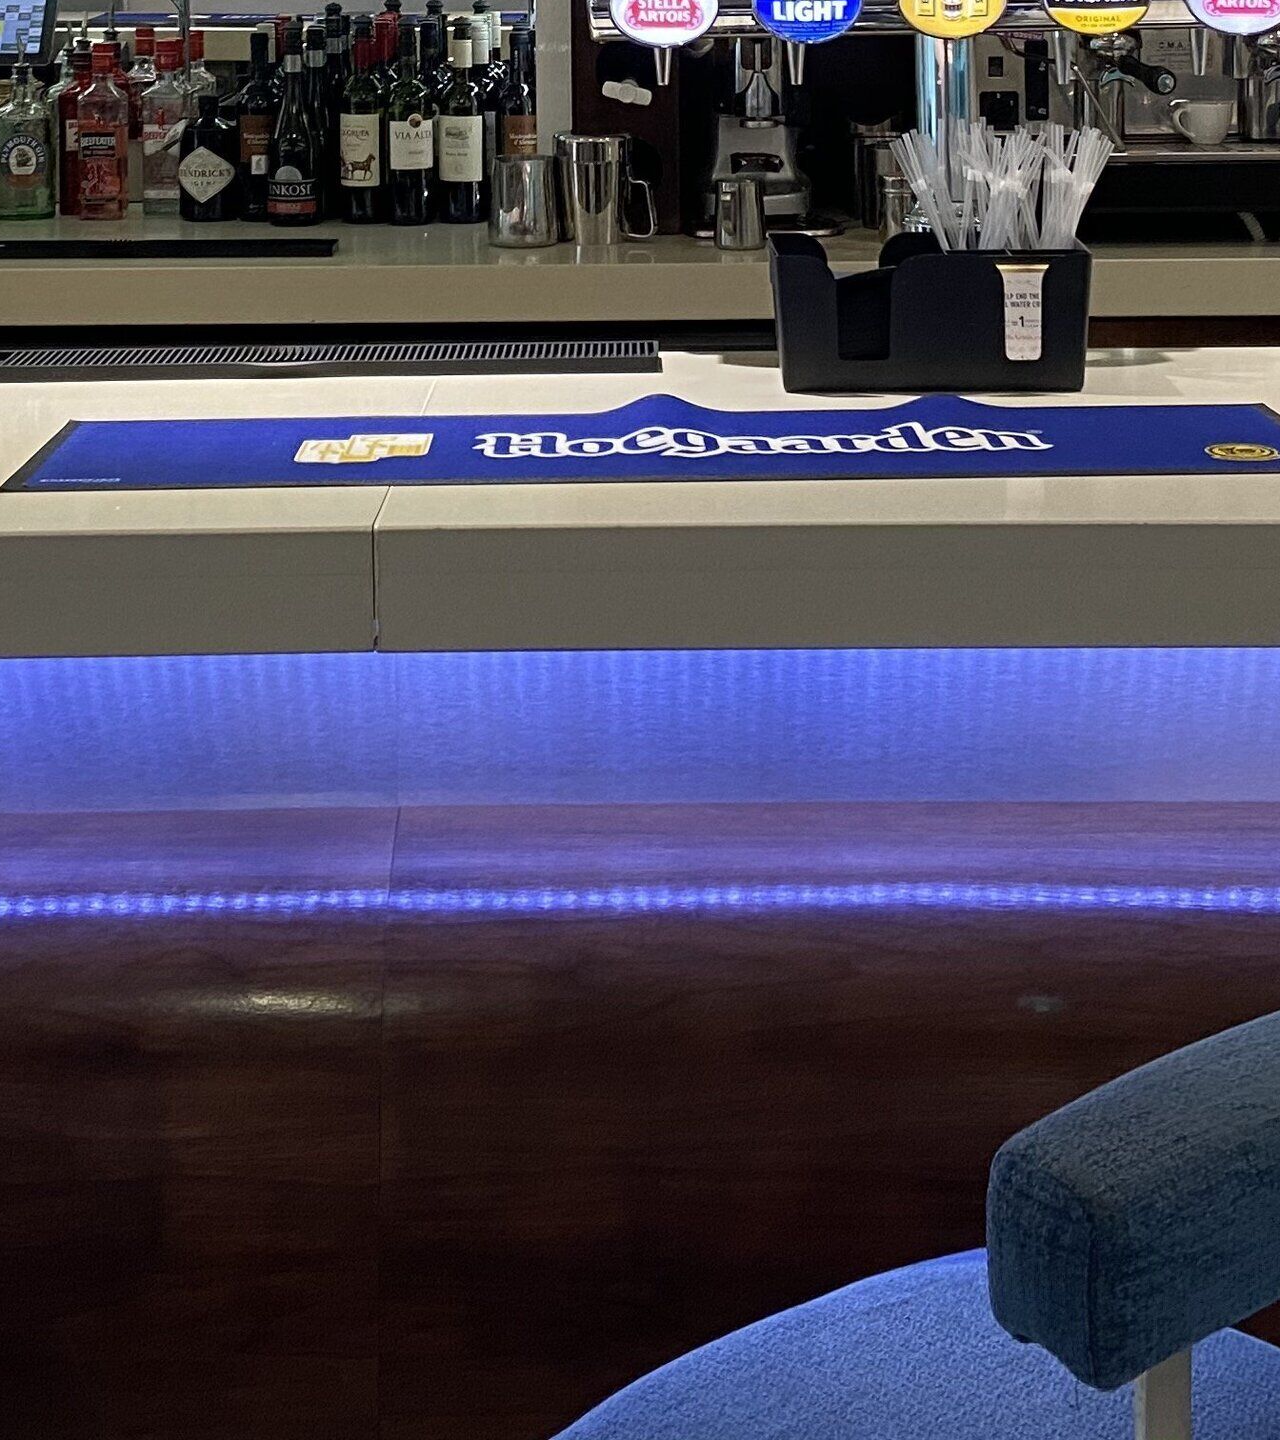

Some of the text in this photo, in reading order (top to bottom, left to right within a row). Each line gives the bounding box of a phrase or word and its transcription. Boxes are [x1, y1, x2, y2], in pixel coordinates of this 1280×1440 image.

[637, 10, 692, 24] ARTOIS
[772, 0, 848, 24] LIGHT
[1075, 15, 1122, 23] ORIGINAL
[394, 128, 412, 141] VIA
[0, 135, 39, 164] PLYMOUTH
[472, 420, 1055, 458] Hoegaarden
